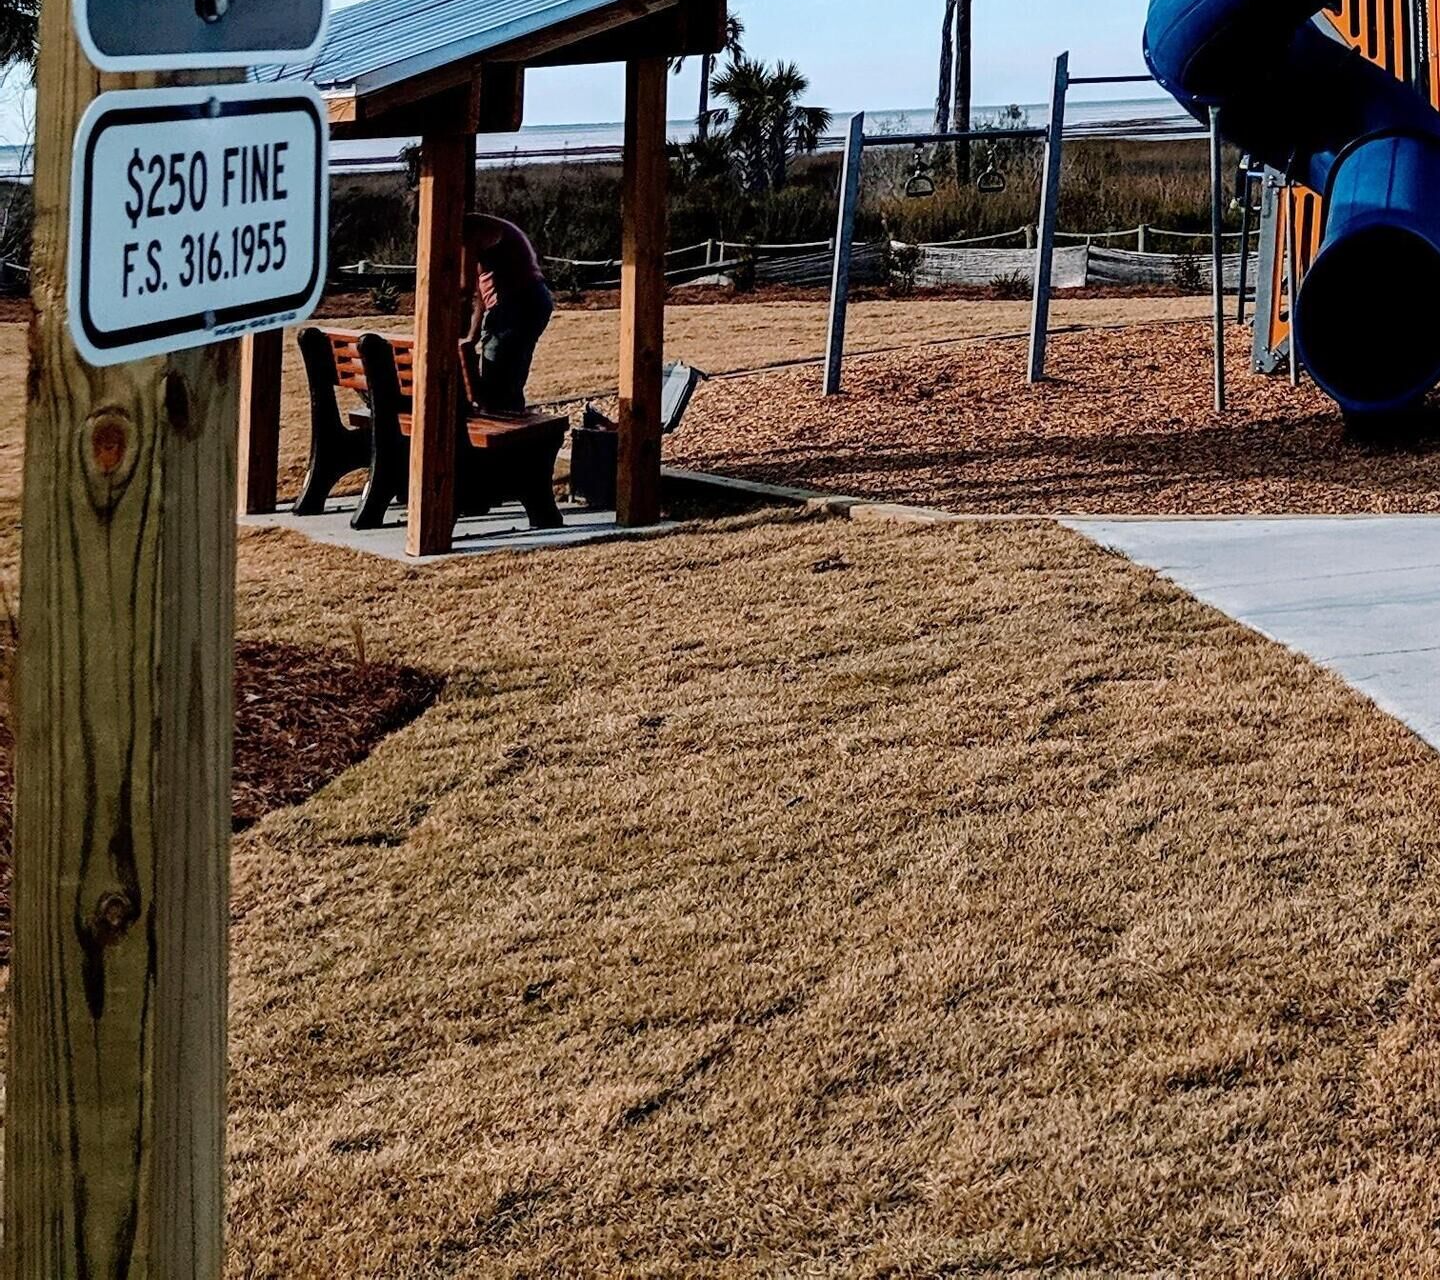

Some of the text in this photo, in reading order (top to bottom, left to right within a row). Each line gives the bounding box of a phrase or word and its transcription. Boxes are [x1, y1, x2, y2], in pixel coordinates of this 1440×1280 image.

[125, 141, 288, 229] $250 FINE
[123, 220, 286, 298] F.S. 316.1955
